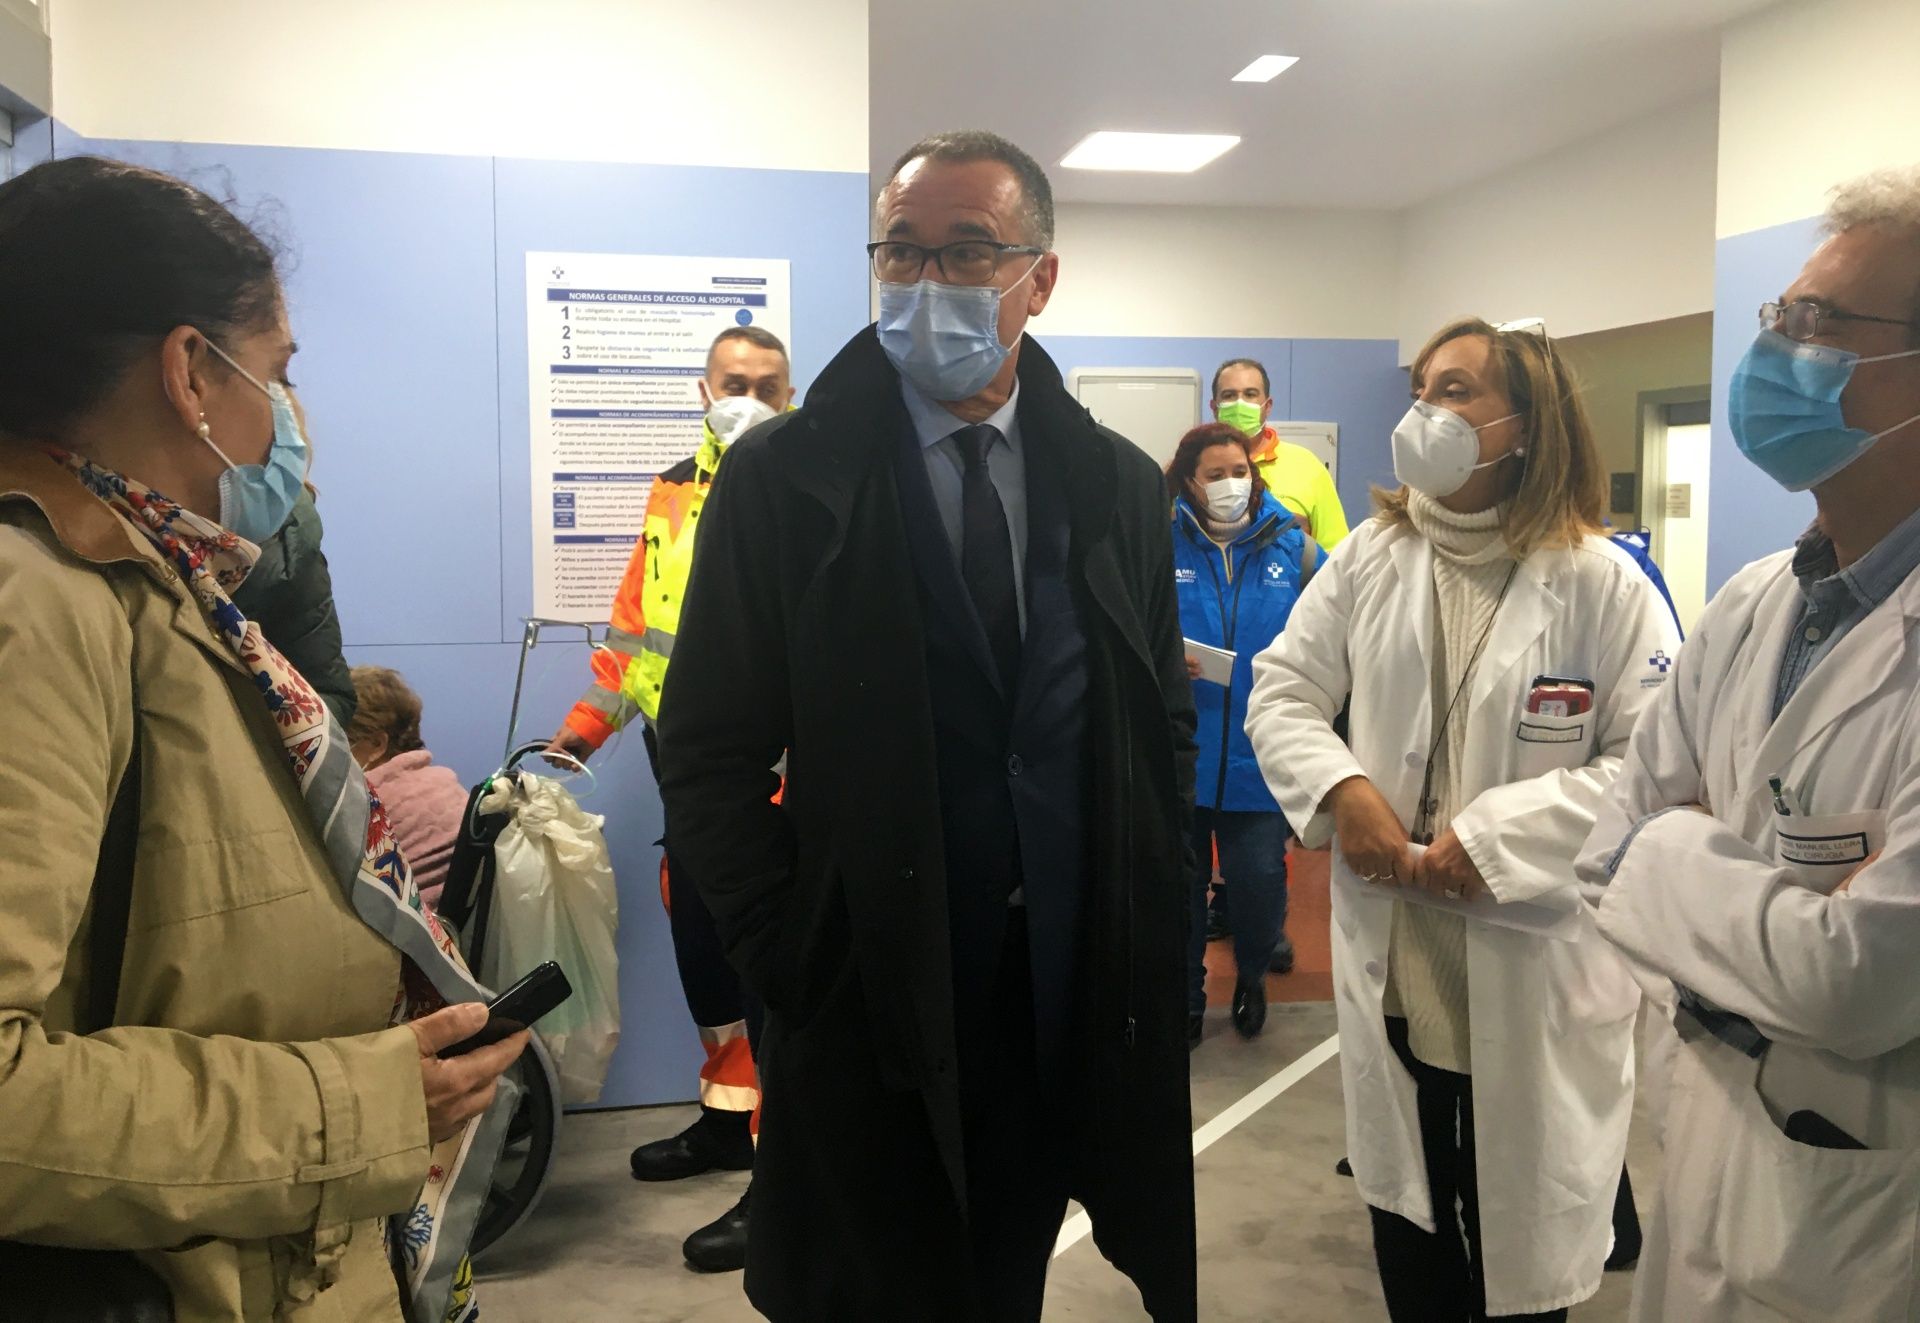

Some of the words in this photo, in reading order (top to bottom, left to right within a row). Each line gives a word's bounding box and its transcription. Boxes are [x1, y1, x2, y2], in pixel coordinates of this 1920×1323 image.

[569, 292, 606, 301] NORMAS
[606, 294, 652, 302] GENERALES
[709, 296, 746, 304] HOSPITAL
[561, 306, 569, 320] 1
[562, 325, 570, 340] 2
[562, 345, 570, 360] 3
[1175, 568, 1196, 578] AMU
[1796, 842, 1831, 850] MANUEL
[1833, 840, 1862, 850] LLERA
[1804, 851, 1846, 860] CIRUGIA
